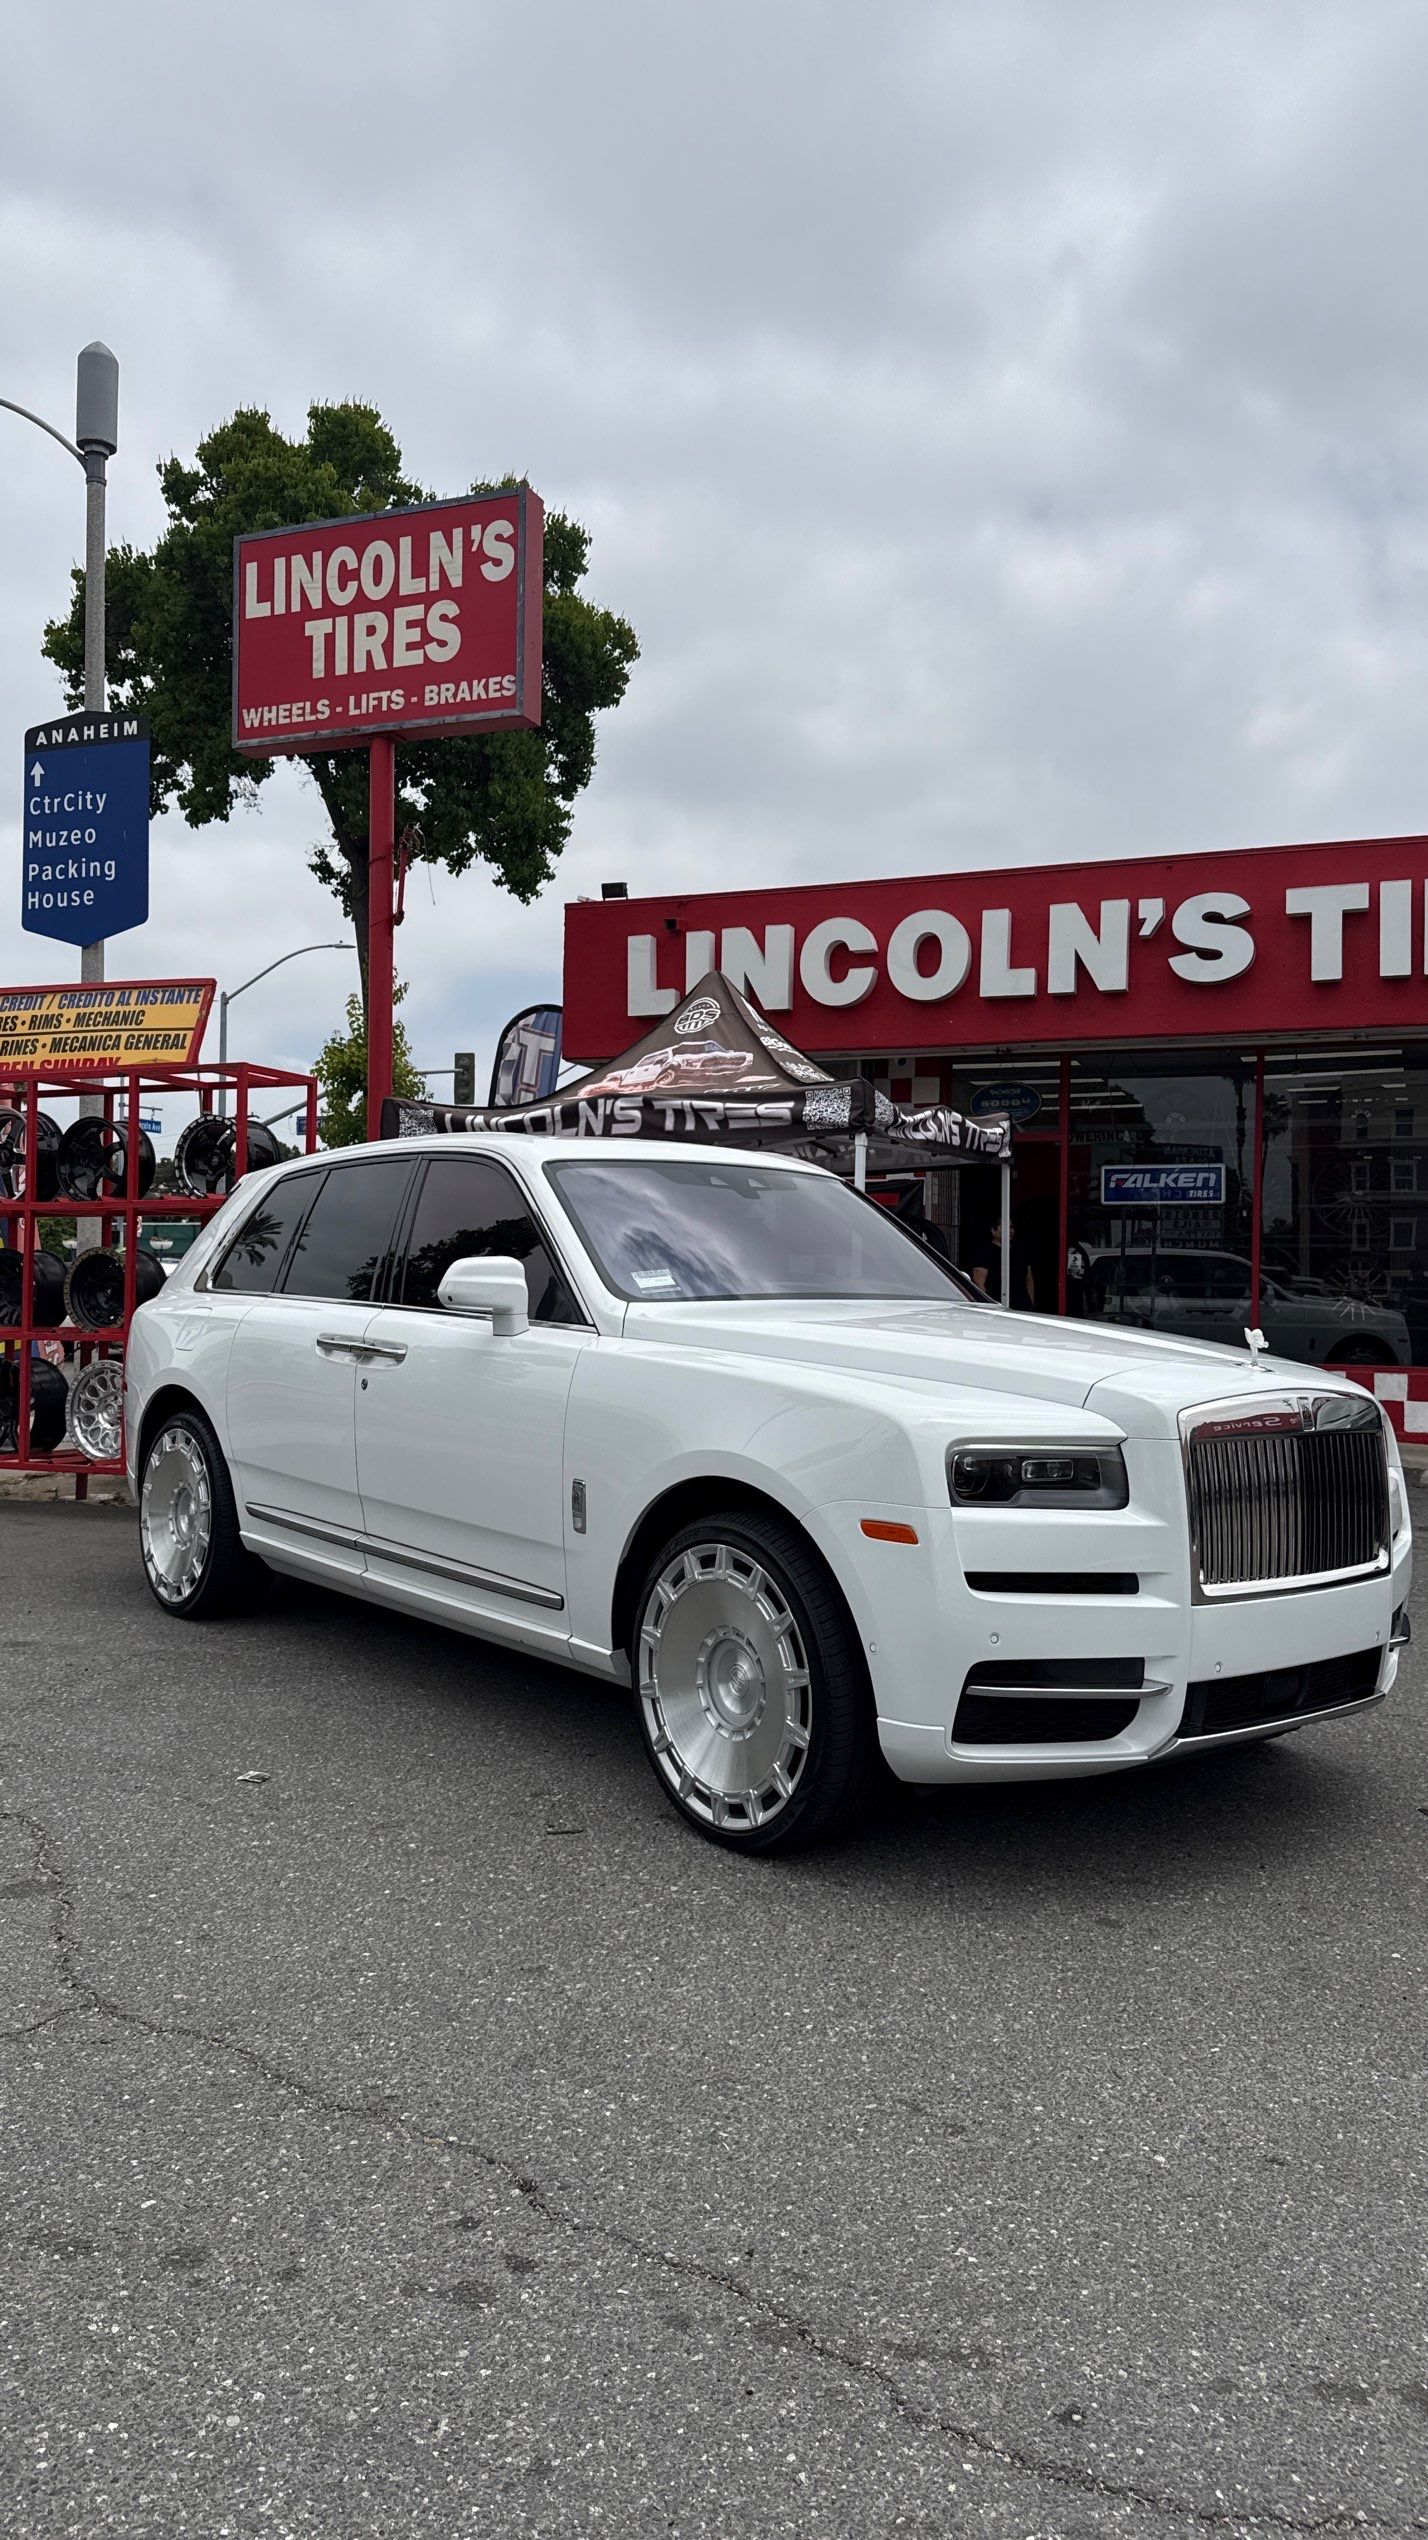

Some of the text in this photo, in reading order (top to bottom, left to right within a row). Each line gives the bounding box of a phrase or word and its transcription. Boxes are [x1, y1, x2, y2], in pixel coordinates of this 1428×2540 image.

[245, 519, 516, 620] LINCOLN'S
[304, 599, 462, 680] TIRES
[242, 698, 331, 729] WHEELS
[349, 688, 406, 716] LIFTS
[424, 674, 517, 707] BRAKES
[35, 720, 139, 746] ANAHEIM
[29, 792, 107, 816] CtrCity
[28, 828, 97, 849] Muzeo
[28, 858, 116, 882] Packing
[27, 889, 95, 910] House
[627, 877, 1428, 1017] LINCOLN'S TI
[0, 994, 47, 1012] CREDIT
[57, 990, 115, 1010] CREDITO
[115, 988, 132, 1007] AL
[134, 987, 202, 1006] INSTANTE
[28, 1012, 64, 1031] RIMS
[73, 1010, 146, 1028] MECHANIC
[49, 1034, 123, 1054] MECANICA
[123, 1033, 188, 1051] GENERAL
[653, 1100, 795, 1132] TIRES
[1109, 1172, 1217, 1188] FALKEN
[1188, 1189, 1214, 1198] TIRES
